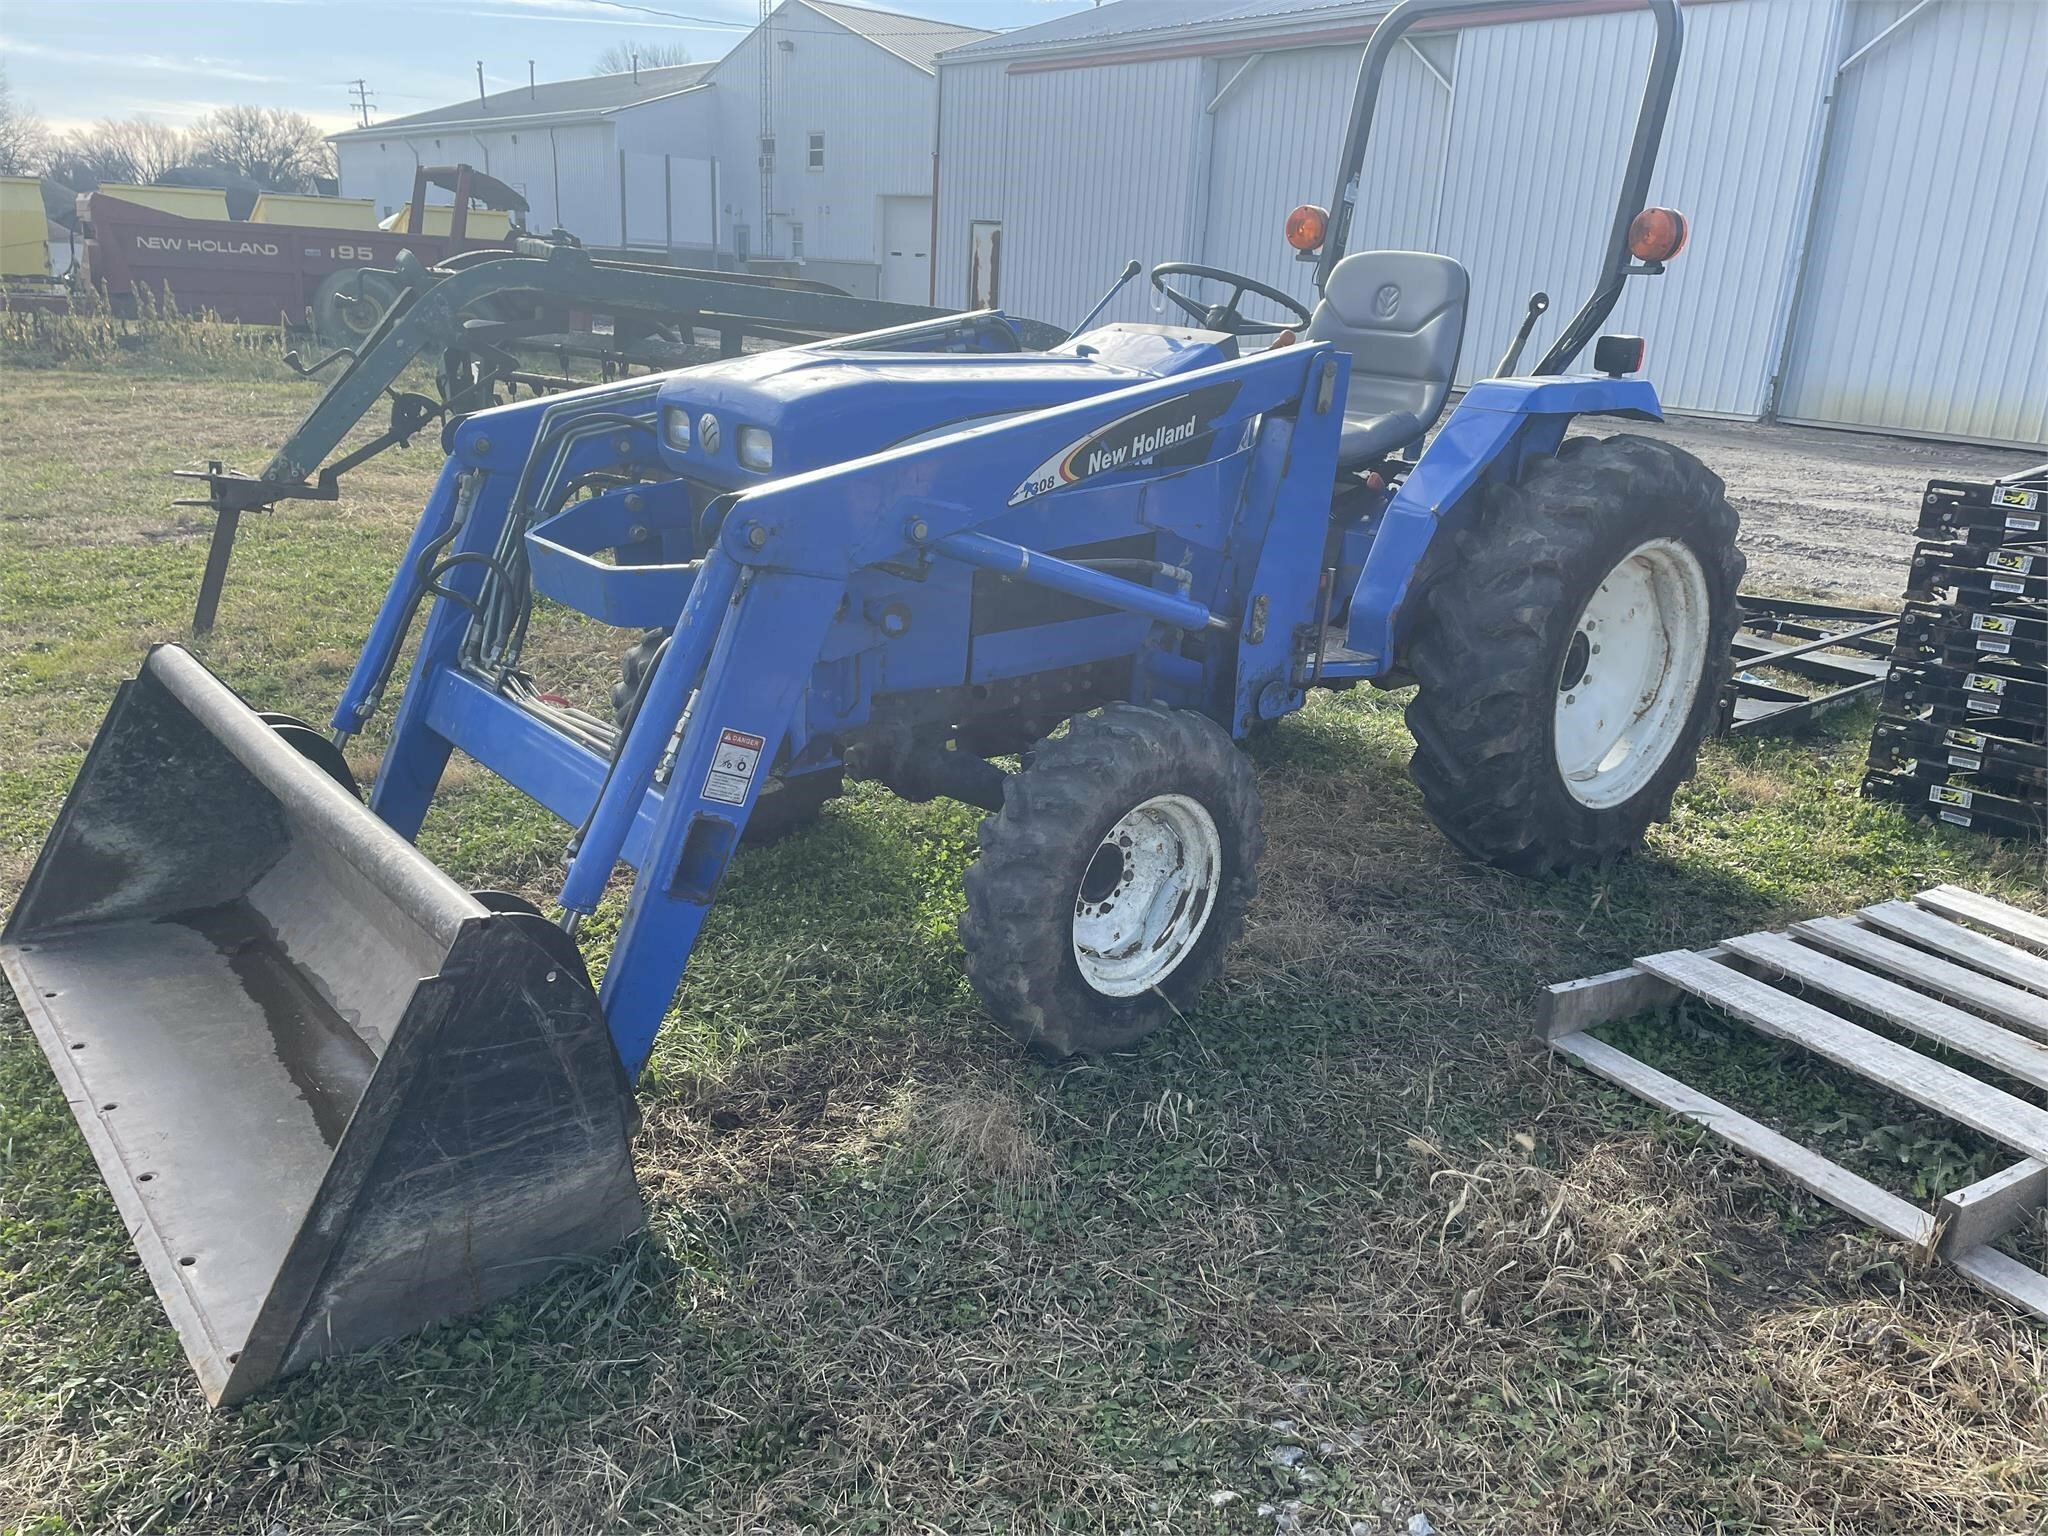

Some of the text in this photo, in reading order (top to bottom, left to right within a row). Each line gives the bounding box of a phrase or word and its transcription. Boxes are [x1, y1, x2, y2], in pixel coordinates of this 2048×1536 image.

[136, 236, 279, 256] NEW HOLLAND
[330, 245, 373, 260] 195
[1087, 414, 1196, 475] New Holland
[732, 735, 760, 747] DANGER
